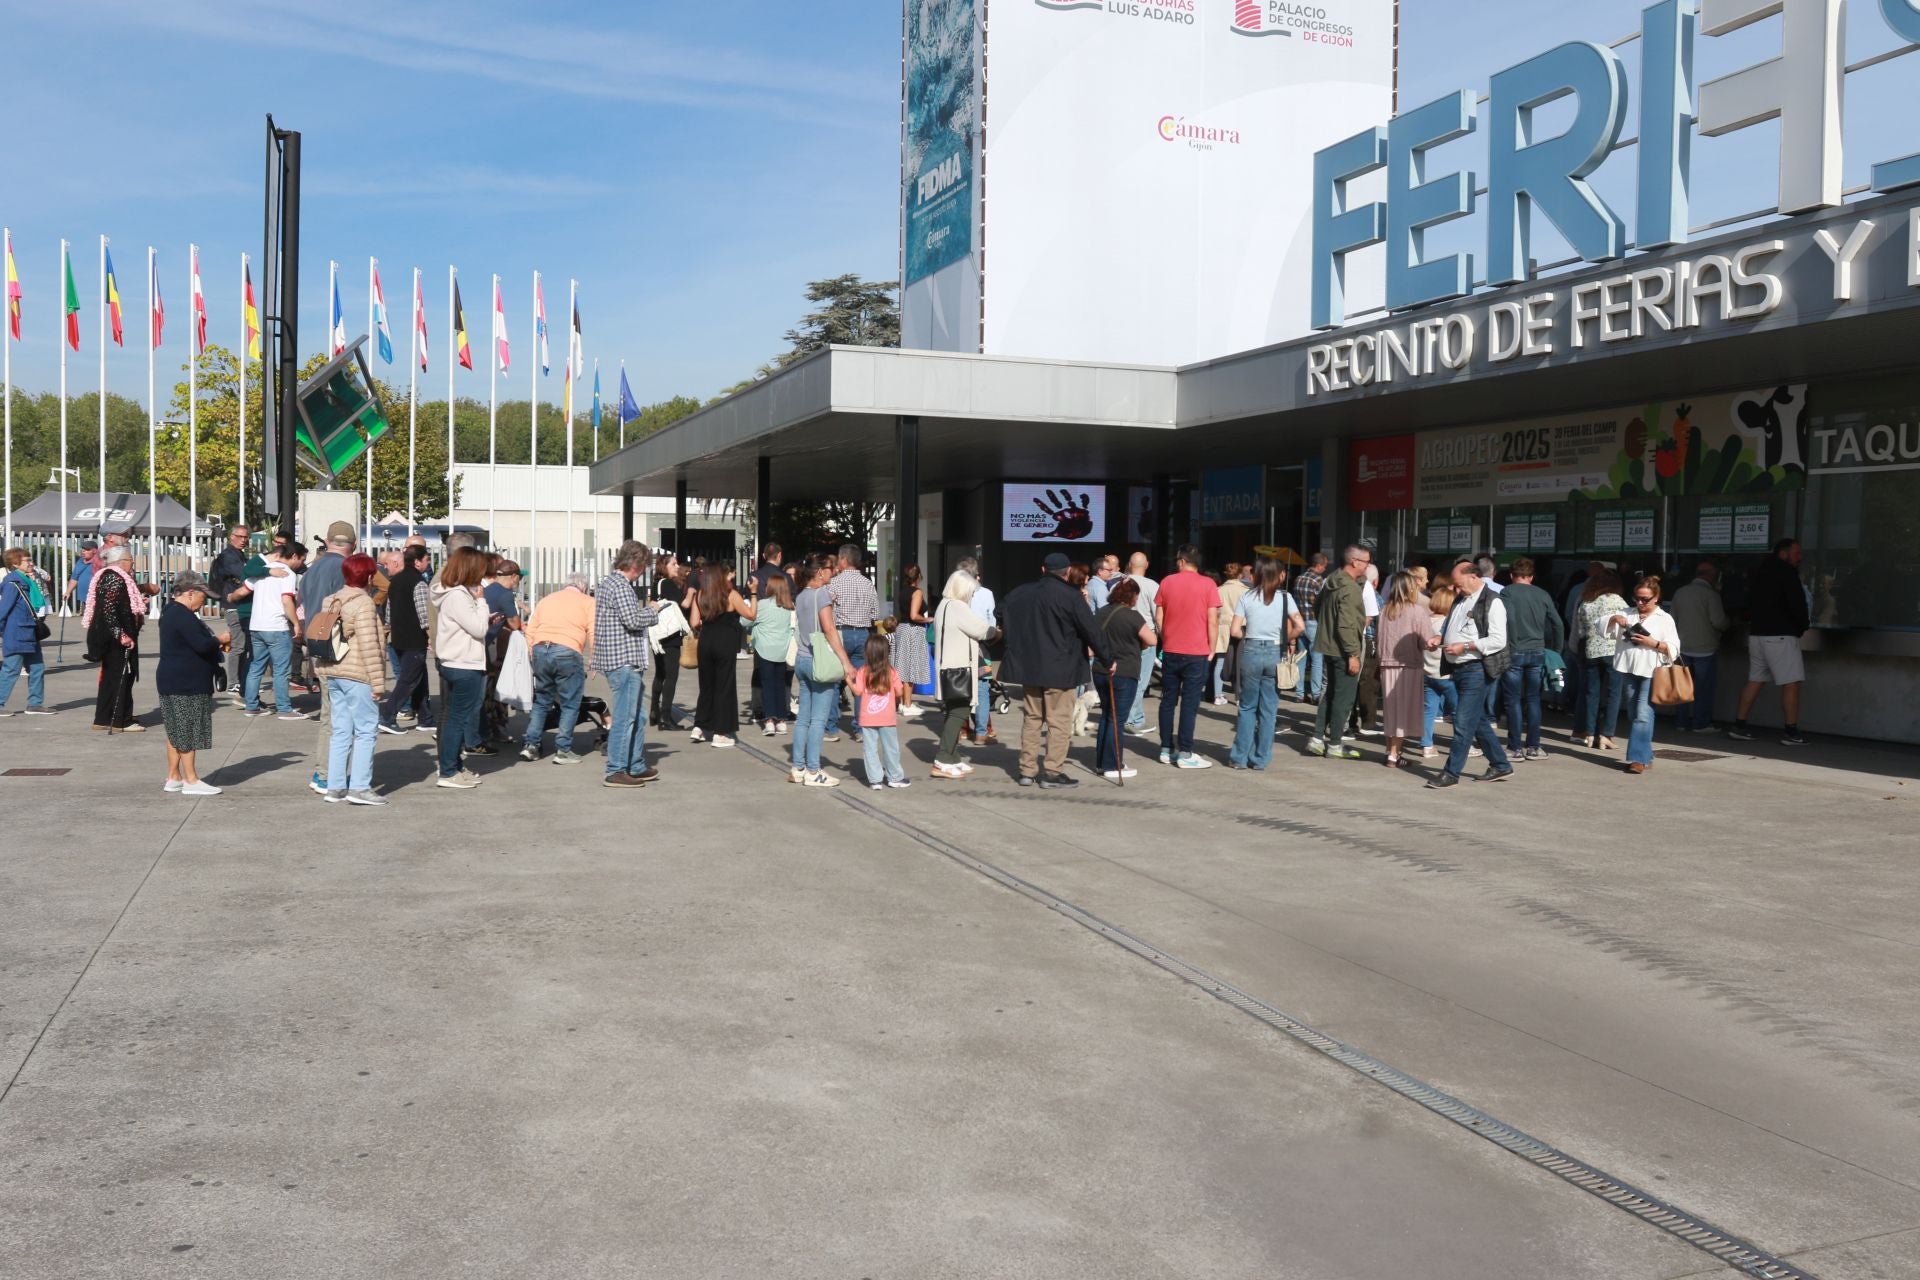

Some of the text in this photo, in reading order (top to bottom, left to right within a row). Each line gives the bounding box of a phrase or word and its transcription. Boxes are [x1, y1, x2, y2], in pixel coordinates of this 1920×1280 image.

[1108, 1, 1194, 25] LUIS ADARO
[1130, 0, 1194, 11] URIAS
[1269, 1, 1326, 19] PALACIO
[1269, 14, 1353, 36] DE CONGRESOS
[1303, 31, 1353, 48] DE GIJÓN
[1157, 115, 1240, 144] Cámara
[1188, 139, 1213, 152] Gijón
[917, 151, 962, 206] FIDMA
[1306, 313, 1474, 395] RECINTO
[1488, 292, 1554, 362] DE
[1570, 239, 1785, 348] FERIAS
[1813, 219, 1875, 300] Y
[1563, 425, 1580, 438] FERIA
[1594, 421, 1616, 434] CAMPO
[1421, 428, 1550, 470] AGROPEC 2025
[1203, 493, 1261, 513] ENTRADA
[1739, 523, 1757, 533] 2,60
[1758, 523, 1765, 532] €
